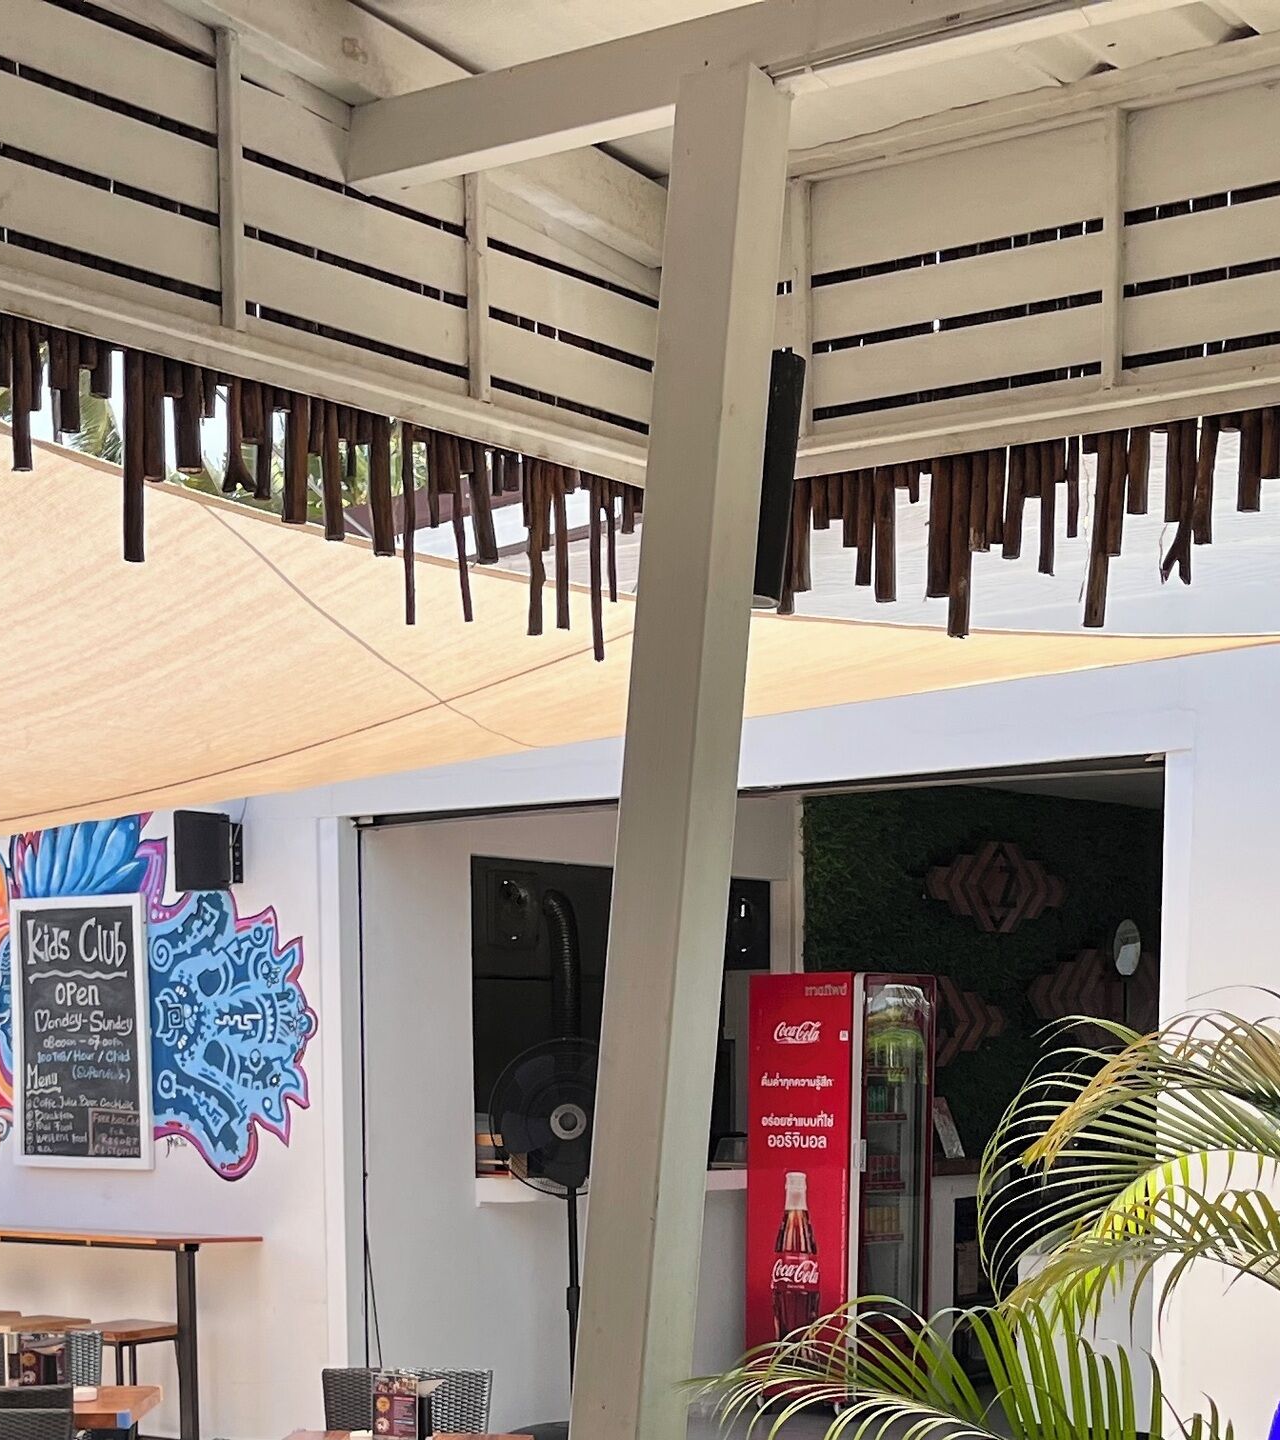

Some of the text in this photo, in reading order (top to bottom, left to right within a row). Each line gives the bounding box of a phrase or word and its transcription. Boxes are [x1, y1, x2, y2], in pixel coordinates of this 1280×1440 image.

[26, 917, 127, 967] Kids Club
[774, 1021, 821, 1044] Coca-Cola
[26, 1063, 58, 1090] Menu
[767, 1131, 827, 1149] ออริจินอล
[771, 1258, 819, 1285] Coca-Cola
